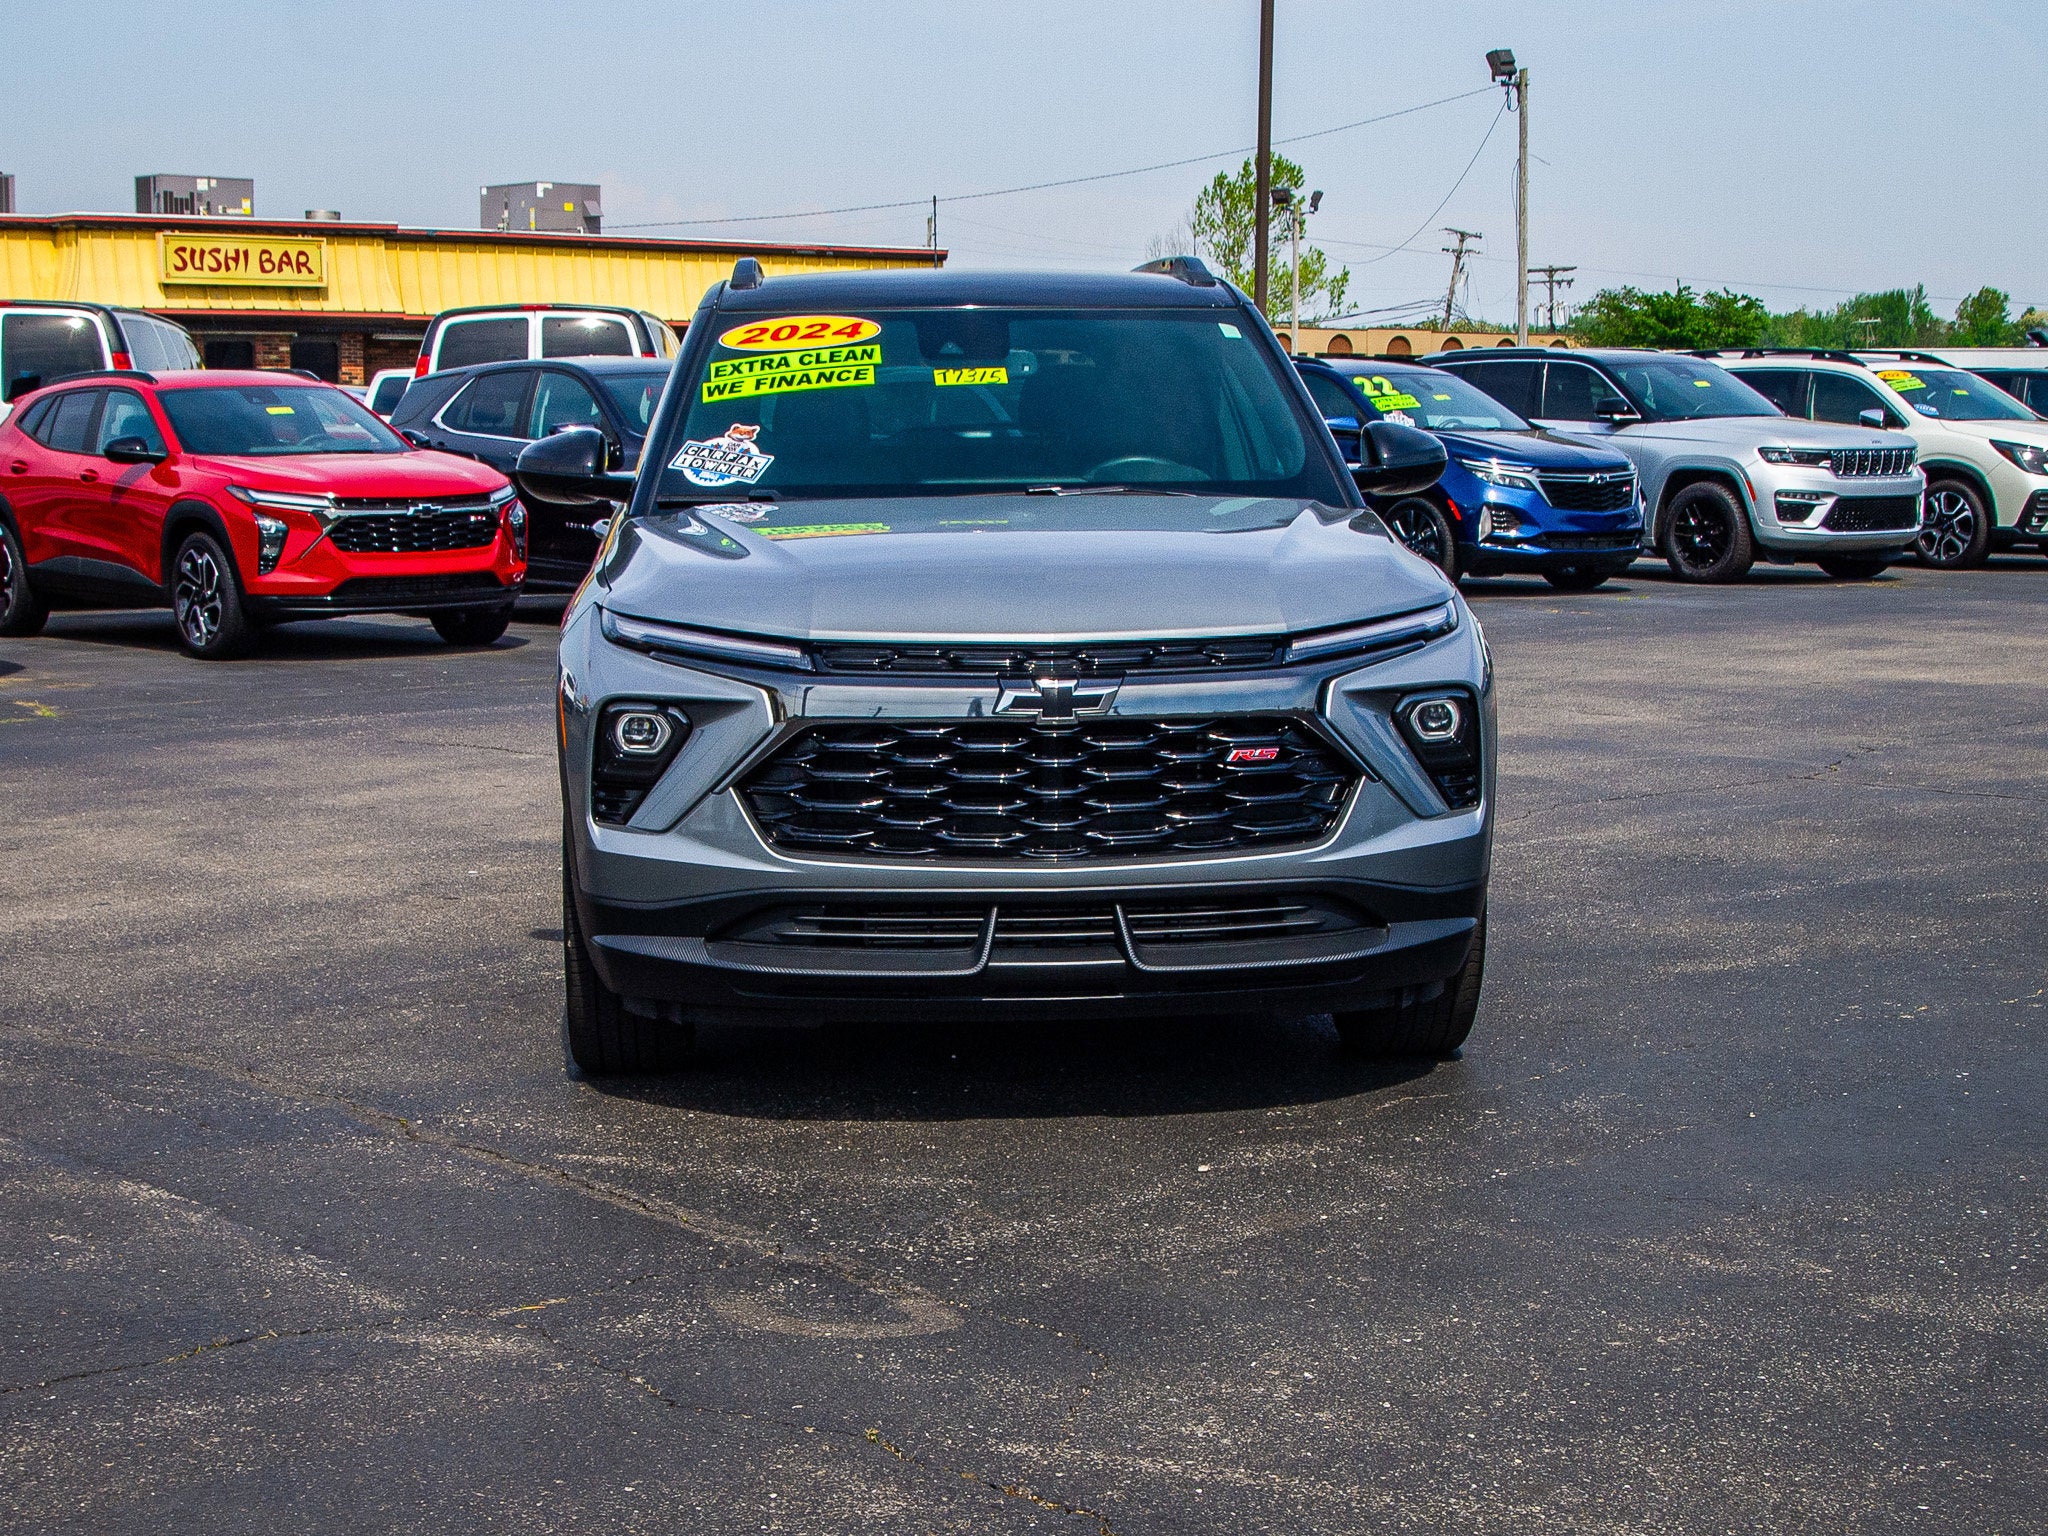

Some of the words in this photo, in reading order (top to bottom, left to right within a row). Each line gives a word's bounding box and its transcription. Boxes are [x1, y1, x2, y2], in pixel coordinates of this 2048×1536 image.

[173, 246, 249, 273] SUSHI
[259, 248, 314, 274] BAR
[735, 321, 864, 346] 2024
[713, 355, 791, 379] EXTRA
[799, 347, 876, 366] CLEAN
[706, 380, 745, 398] WE
[754, 367, 870, 391] FINANCE
[1352, 375, 1400, 397] 22
[684, 445, 761, 469] CARFAX
[691, 457, 759, 479] OWNER
[1225, 748, 1280, 762] RS
